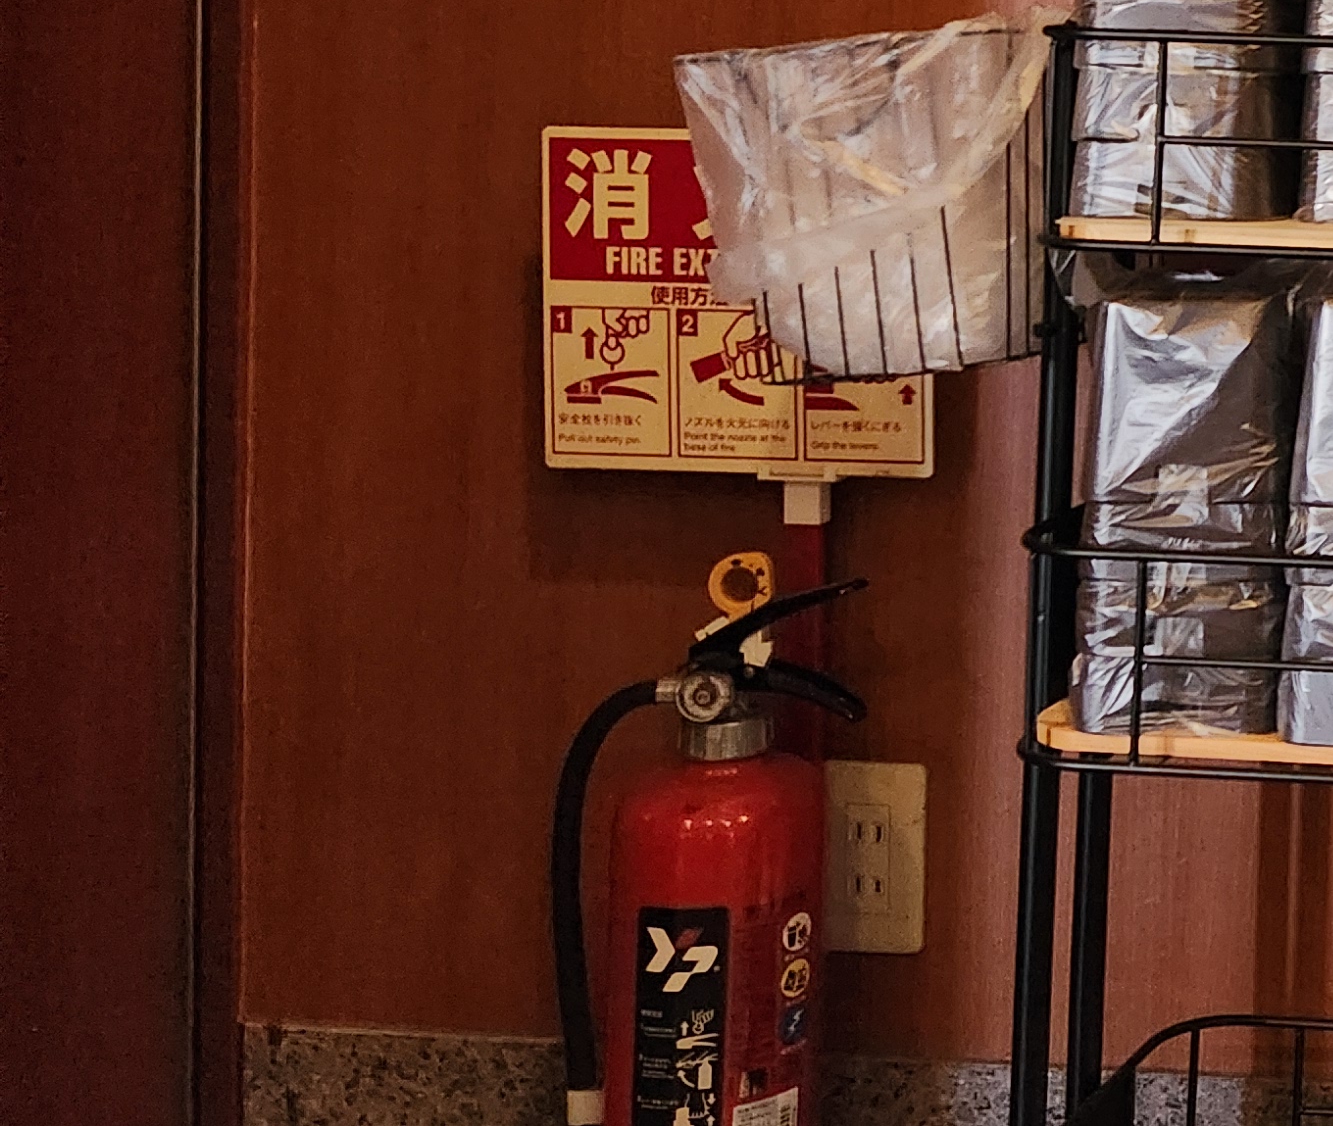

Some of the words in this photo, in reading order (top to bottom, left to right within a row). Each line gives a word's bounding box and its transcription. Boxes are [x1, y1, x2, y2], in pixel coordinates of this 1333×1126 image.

[605, 245, 663, 277] FIRE
[556, 312, 567, 330] 1
[682, 314, 695, 334] 2
